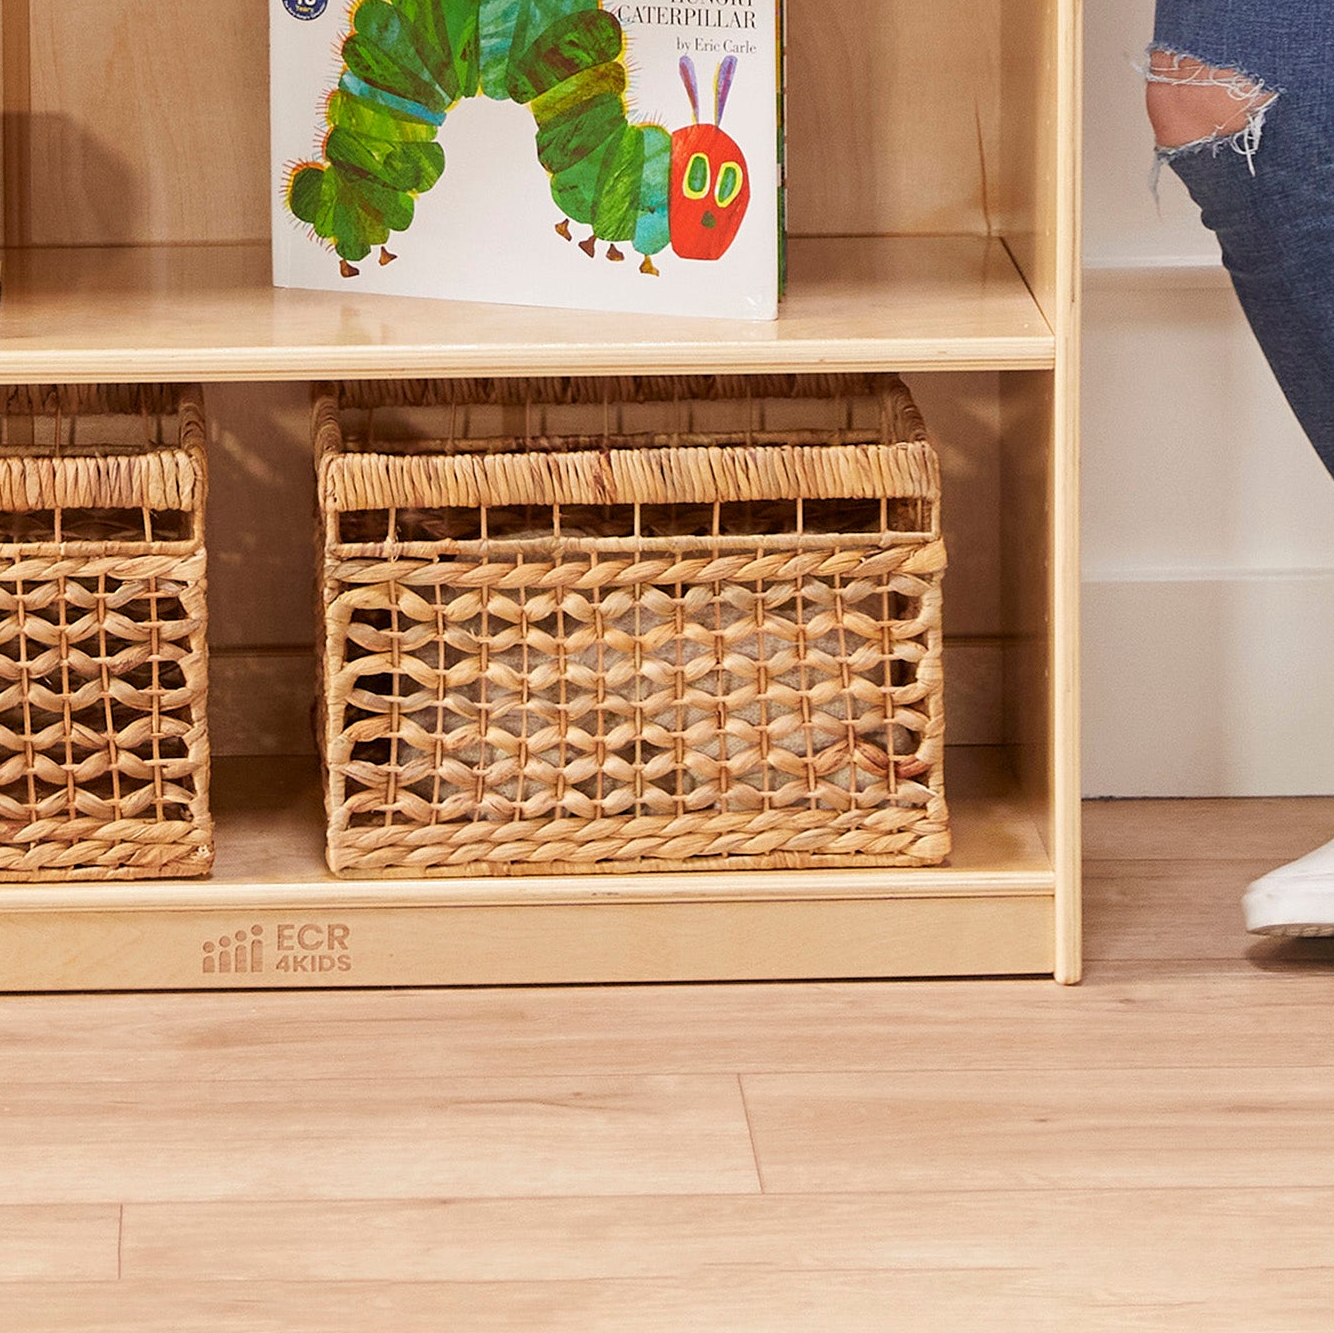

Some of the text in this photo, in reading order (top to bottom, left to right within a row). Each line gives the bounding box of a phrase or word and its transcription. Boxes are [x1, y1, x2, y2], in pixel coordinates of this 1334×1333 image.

[618, 5, 757, 29] CATERPILLAR
[677, 37, 756, 53] by Eric Carle
[277, 924, 350, 950] ECR
[276, 955, 351, 972] 4KIDS
